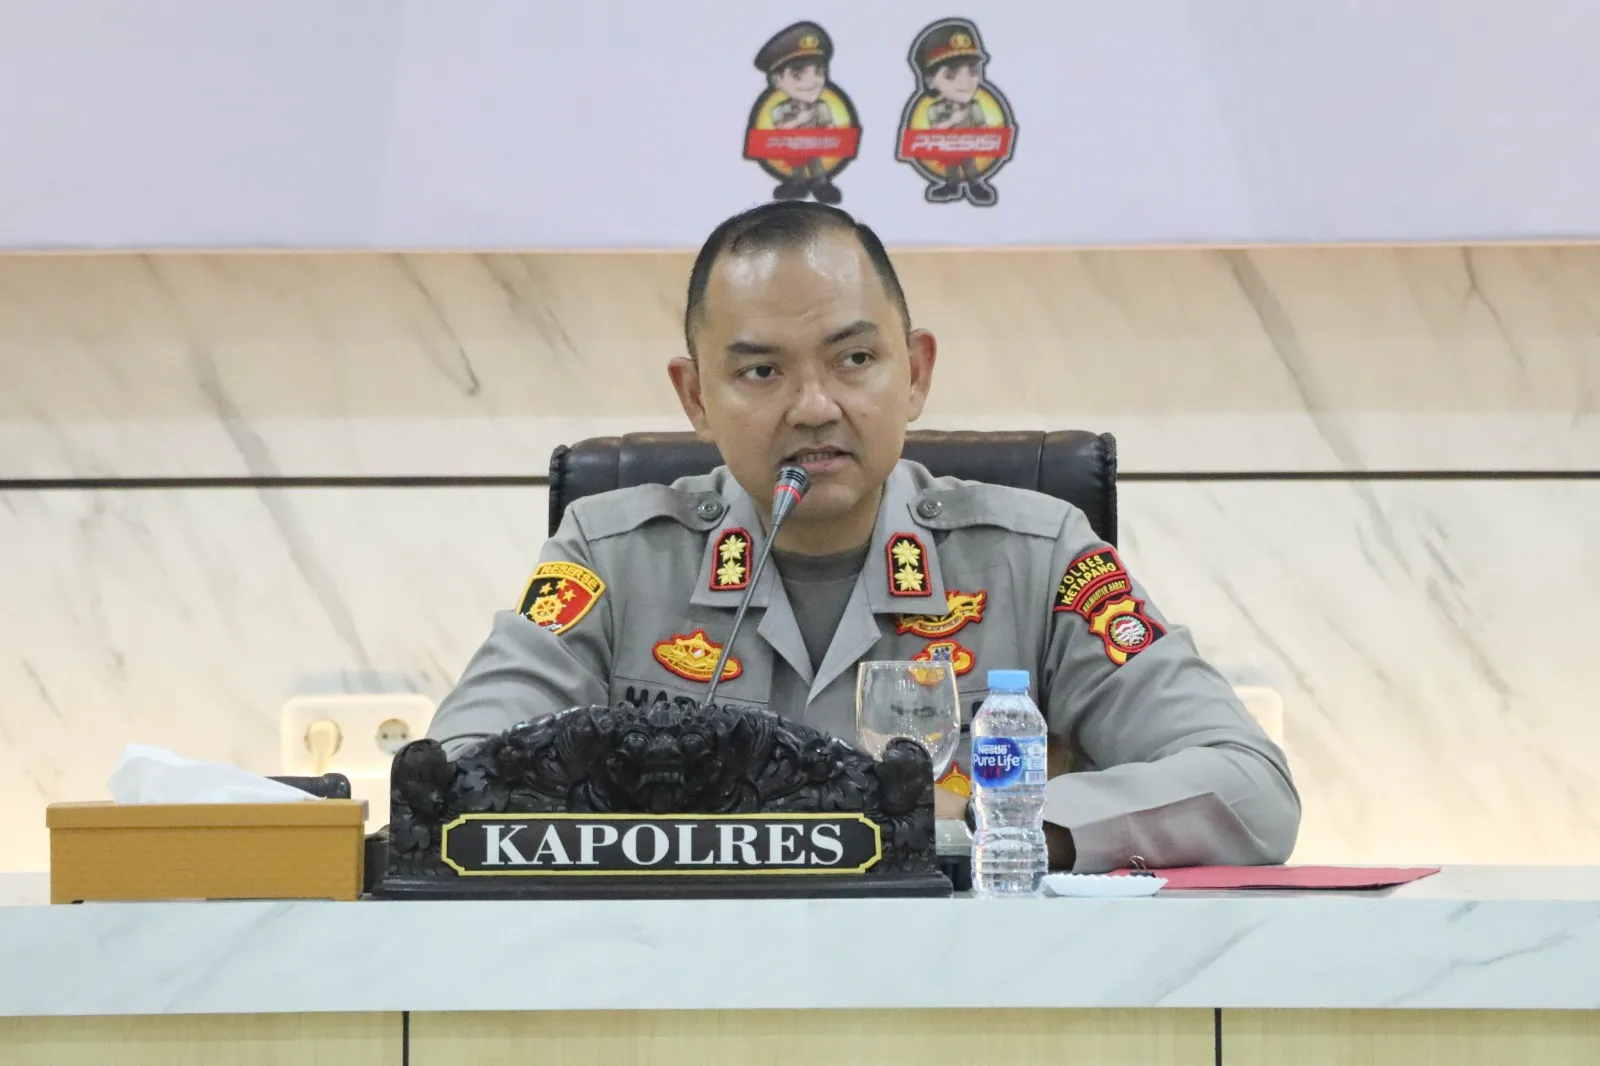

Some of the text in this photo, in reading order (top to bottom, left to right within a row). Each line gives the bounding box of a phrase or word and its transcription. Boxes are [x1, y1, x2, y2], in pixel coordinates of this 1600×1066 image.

[911, 134, 1001, 152] PRESISI
[541, 565, 599, 590] RESERSE
[1059, 555, 1104, 594] POLRES
[1062, 562, 1117, 605] KETAPANG
[973, 754, 996, 767] Pure
[997, 754, 1020, 772] Life
[481, 824, 844, 866] KAPOLRES
